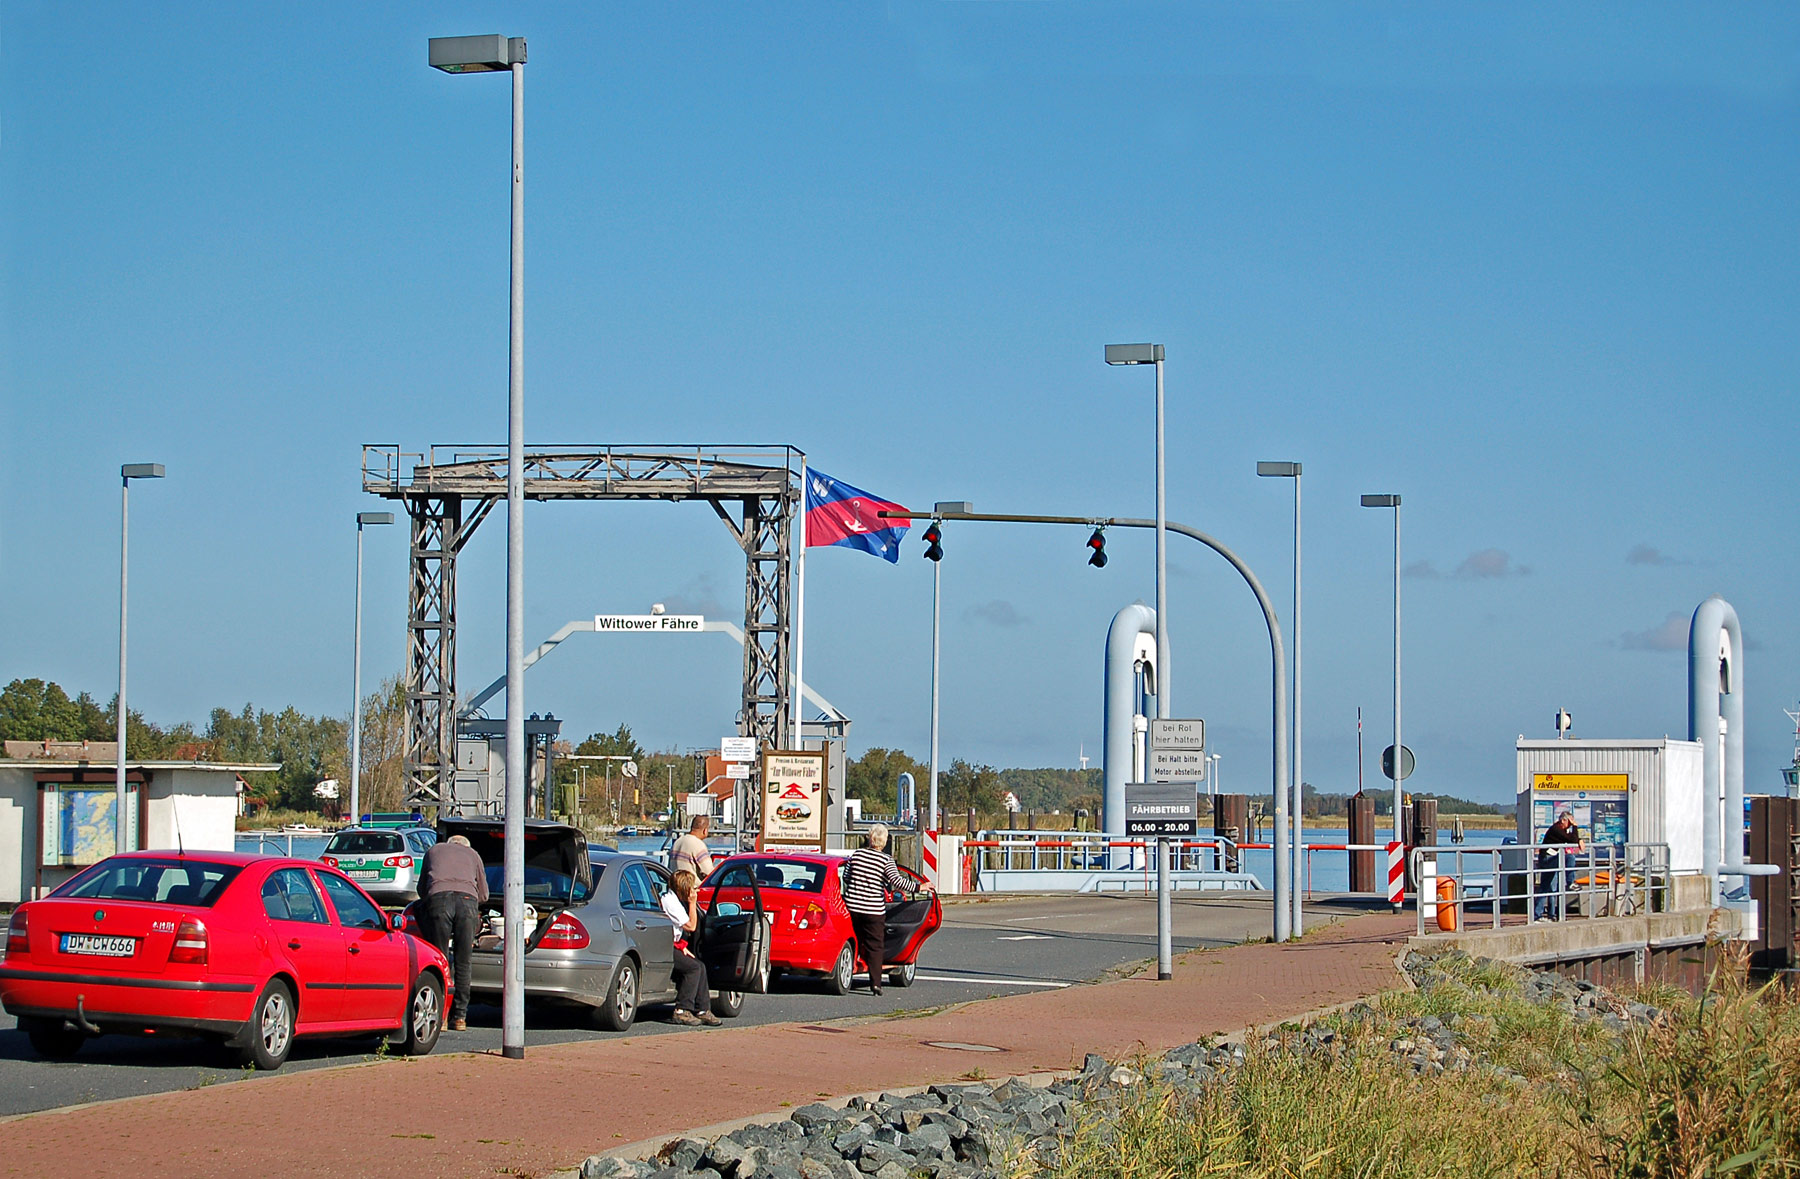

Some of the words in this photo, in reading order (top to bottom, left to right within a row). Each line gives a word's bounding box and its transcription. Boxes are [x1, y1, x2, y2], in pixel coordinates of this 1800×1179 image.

[600, 618, 657, 629] Wittower
[662, 618, 699, 629] Fähre
[1163, 724, 1175, 732] bei
[1178, 724, 1192, 732] Rot
[1156, 736, 1170, 744] hier
[1174, 736, 1199, 744] halten
[1158, 755, 1168, 763] Bei
[1170, 755, 1182, 763] Halt
[1184, 755, 1198, 763] bitte
[1154, 768, 1172, 776] Motor
[1174, 768, 1202, 776] abstellen
[1132, 804, 1190, 814] FÄHRBETRIEB
[1132, 824, 1156, 832] 06.00
[1164, 824, 1190, 832] 20.00
